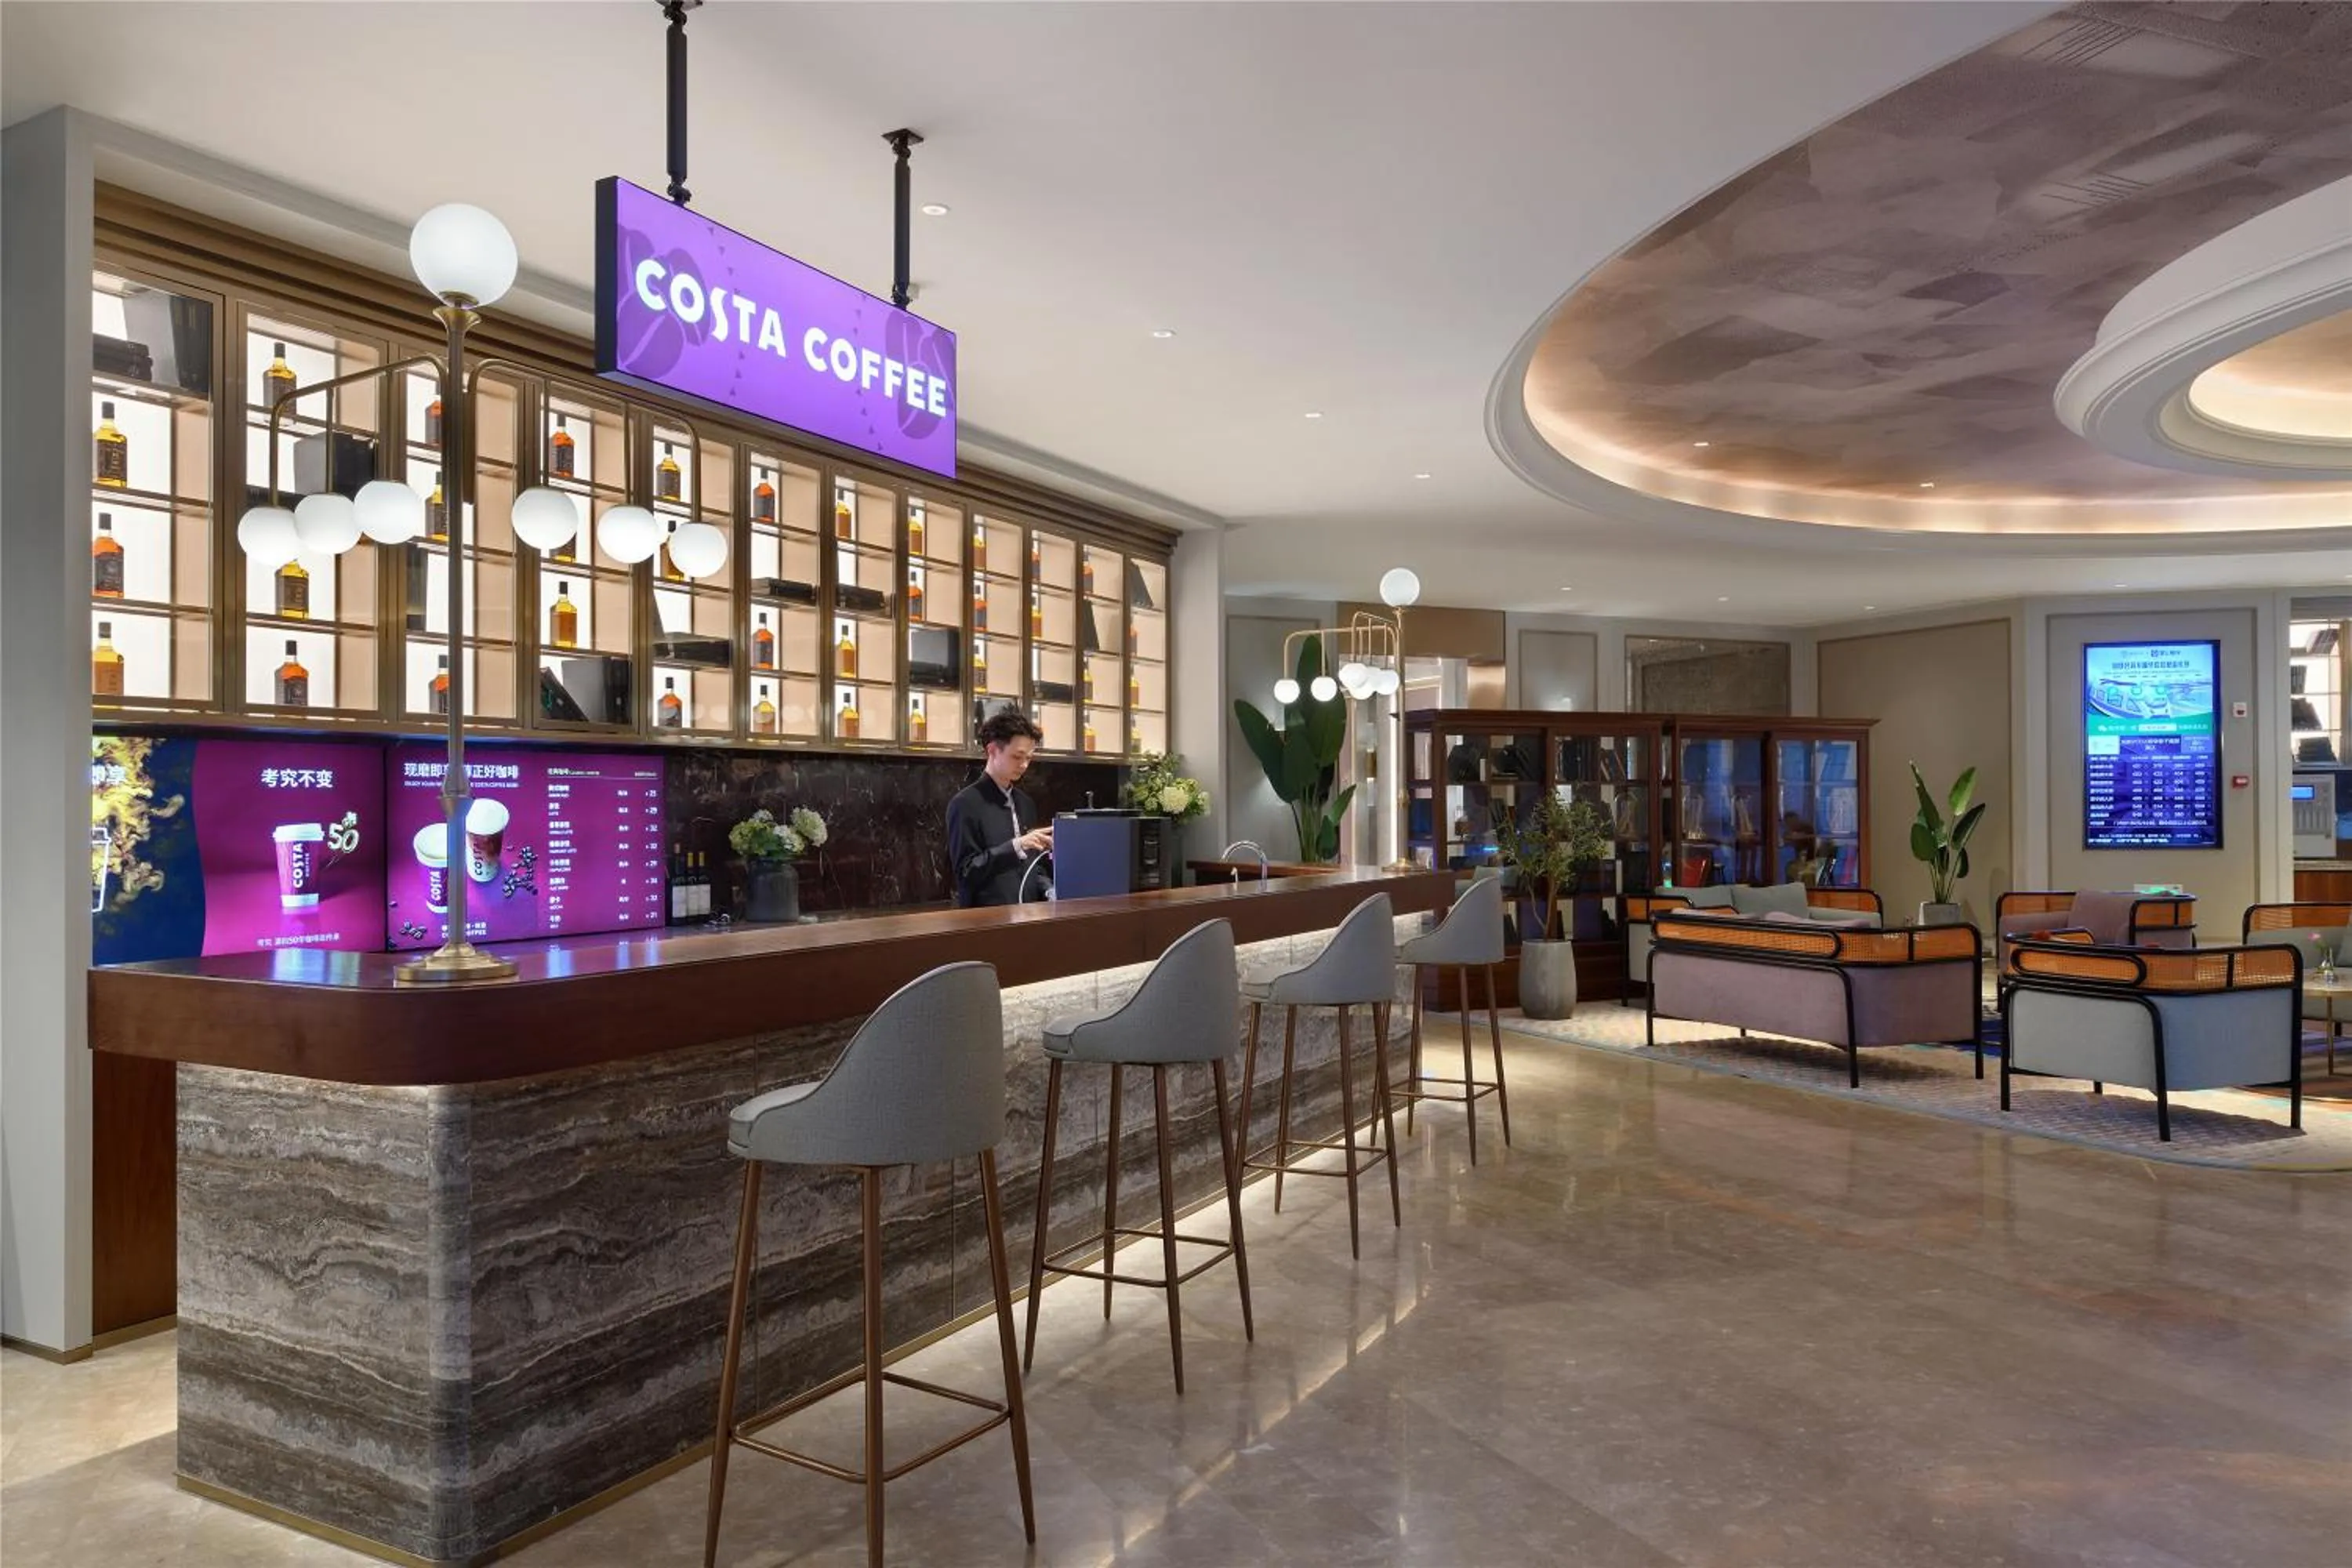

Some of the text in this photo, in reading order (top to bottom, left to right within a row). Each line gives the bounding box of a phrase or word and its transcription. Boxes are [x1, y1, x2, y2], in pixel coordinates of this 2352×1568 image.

[636, 259, 946, 417] COSTA COFFEE
[261, 768, 333, 789] 考究不变
[292, 843, 304, 888] COSTA
